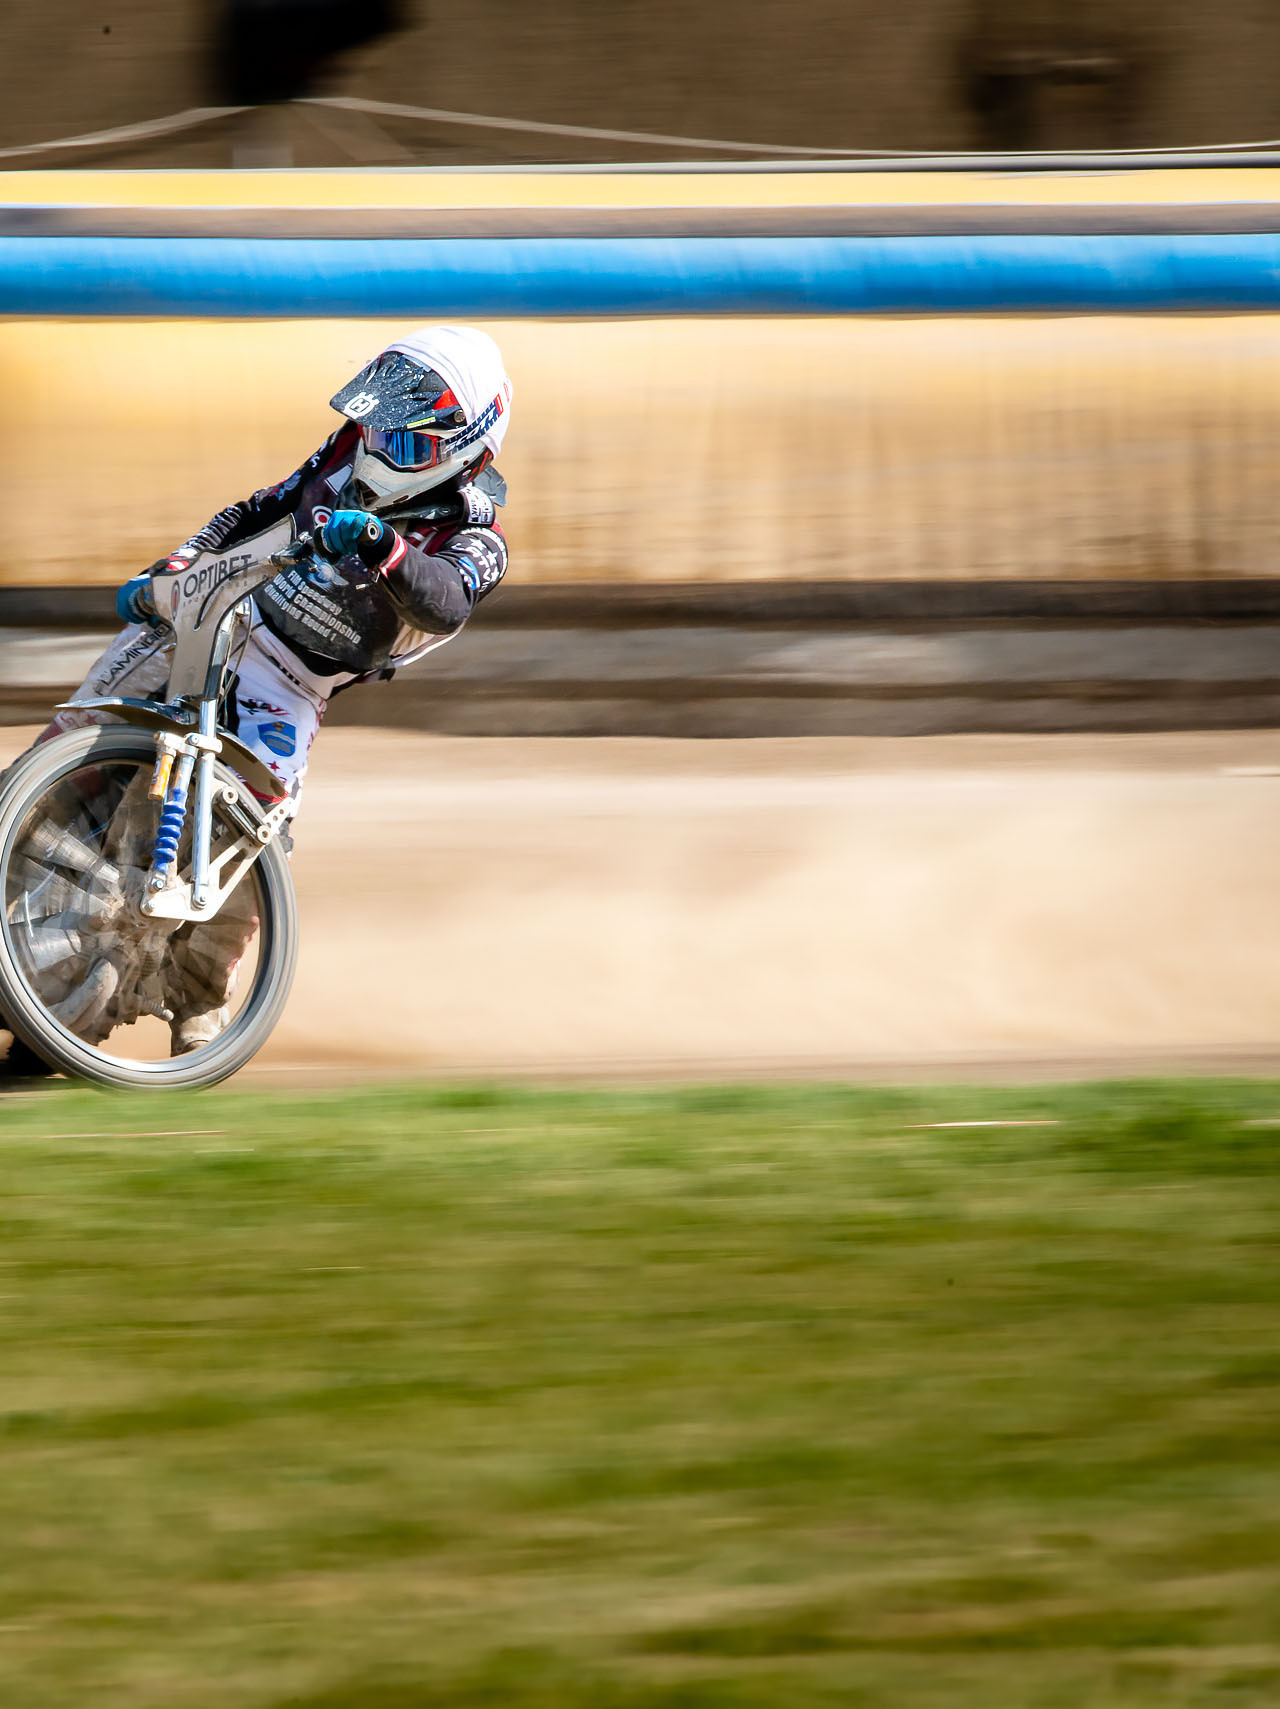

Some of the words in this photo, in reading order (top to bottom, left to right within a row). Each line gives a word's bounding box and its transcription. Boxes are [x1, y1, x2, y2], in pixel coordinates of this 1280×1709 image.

[183, 554, 252, 598] OPTIBET
[287, 569, 302, 586] FIM
[298, 581, 343, 615] Speedway
[264, 583, 302, 620] Qualifying
[301, 613, 331, 638] Round
[273, 573, 296, 599] World
[294, 593, 362, 644] Championship
